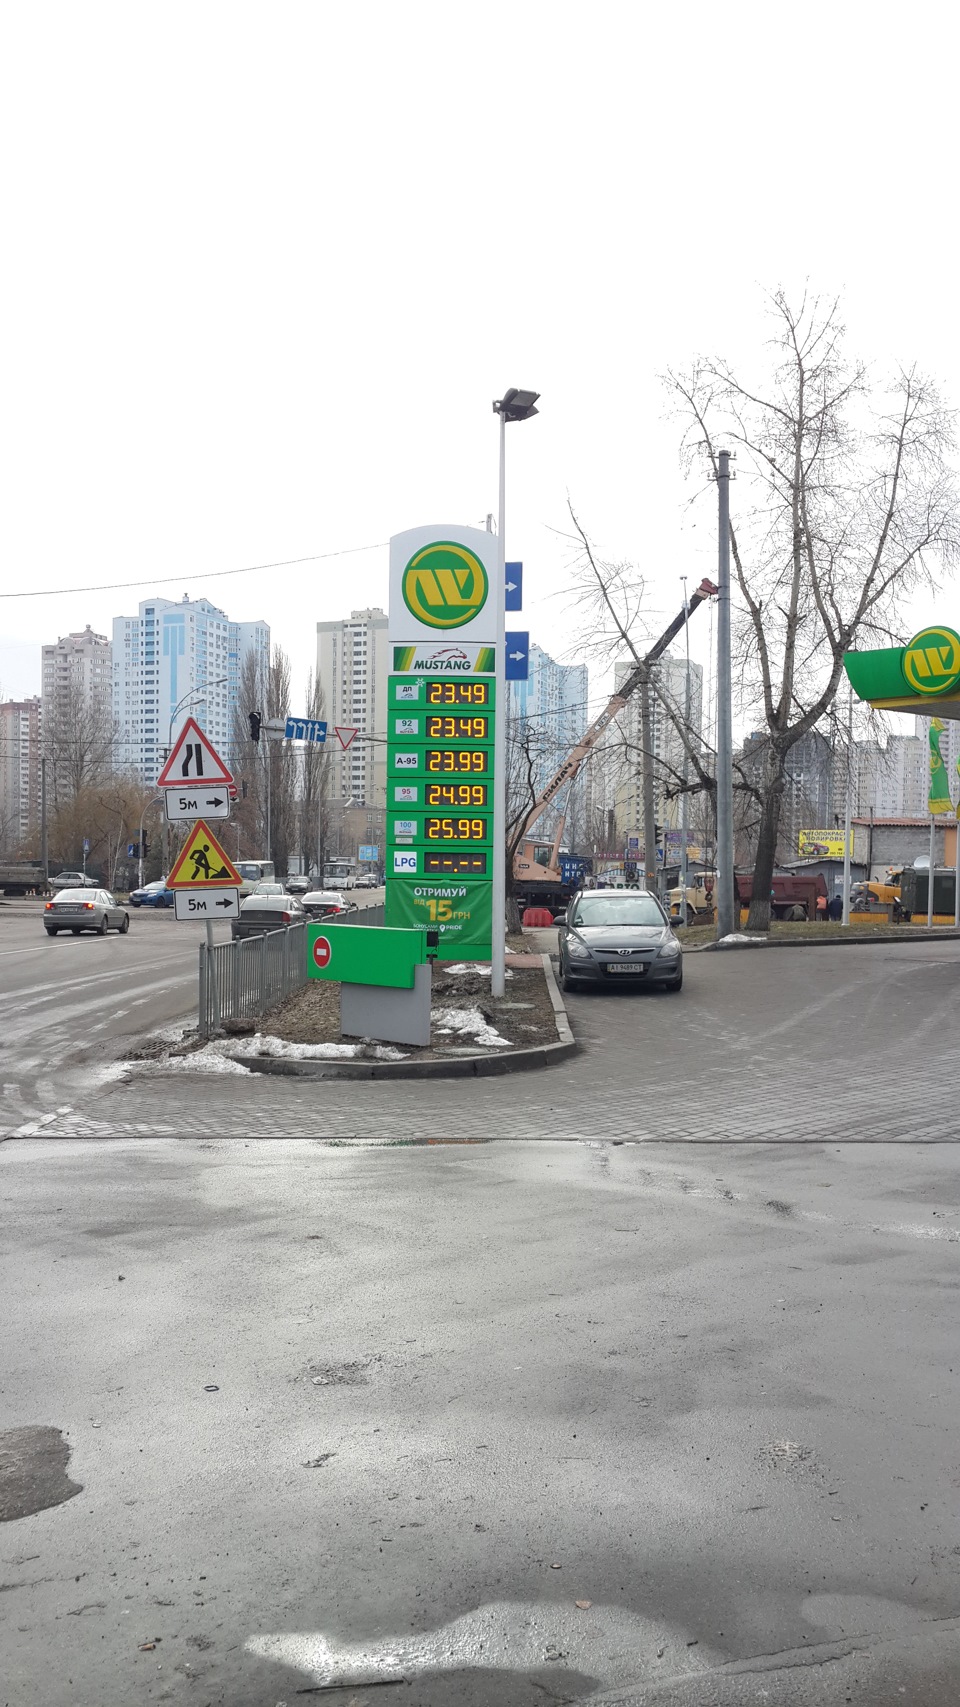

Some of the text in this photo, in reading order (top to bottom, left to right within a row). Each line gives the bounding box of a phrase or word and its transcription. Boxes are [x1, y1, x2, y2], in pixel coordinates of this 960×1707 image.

[413, 660, 471, 670] MUSTANG
[430, 684, 485, 704] 23.49
[430, 717, 485, 737] 23.49
[396, 751, 484, 771] A-95 23.99
[429, 785, 483, 805] 24.99
[428, 819, 483, 839] 25.99
[394, 857, 416, 867] LPG
[413, 886, 467, 897] ОТРИМУЙ
[425, 899, 453, 921] 15
[453, 912, 470, 920] ГРН
